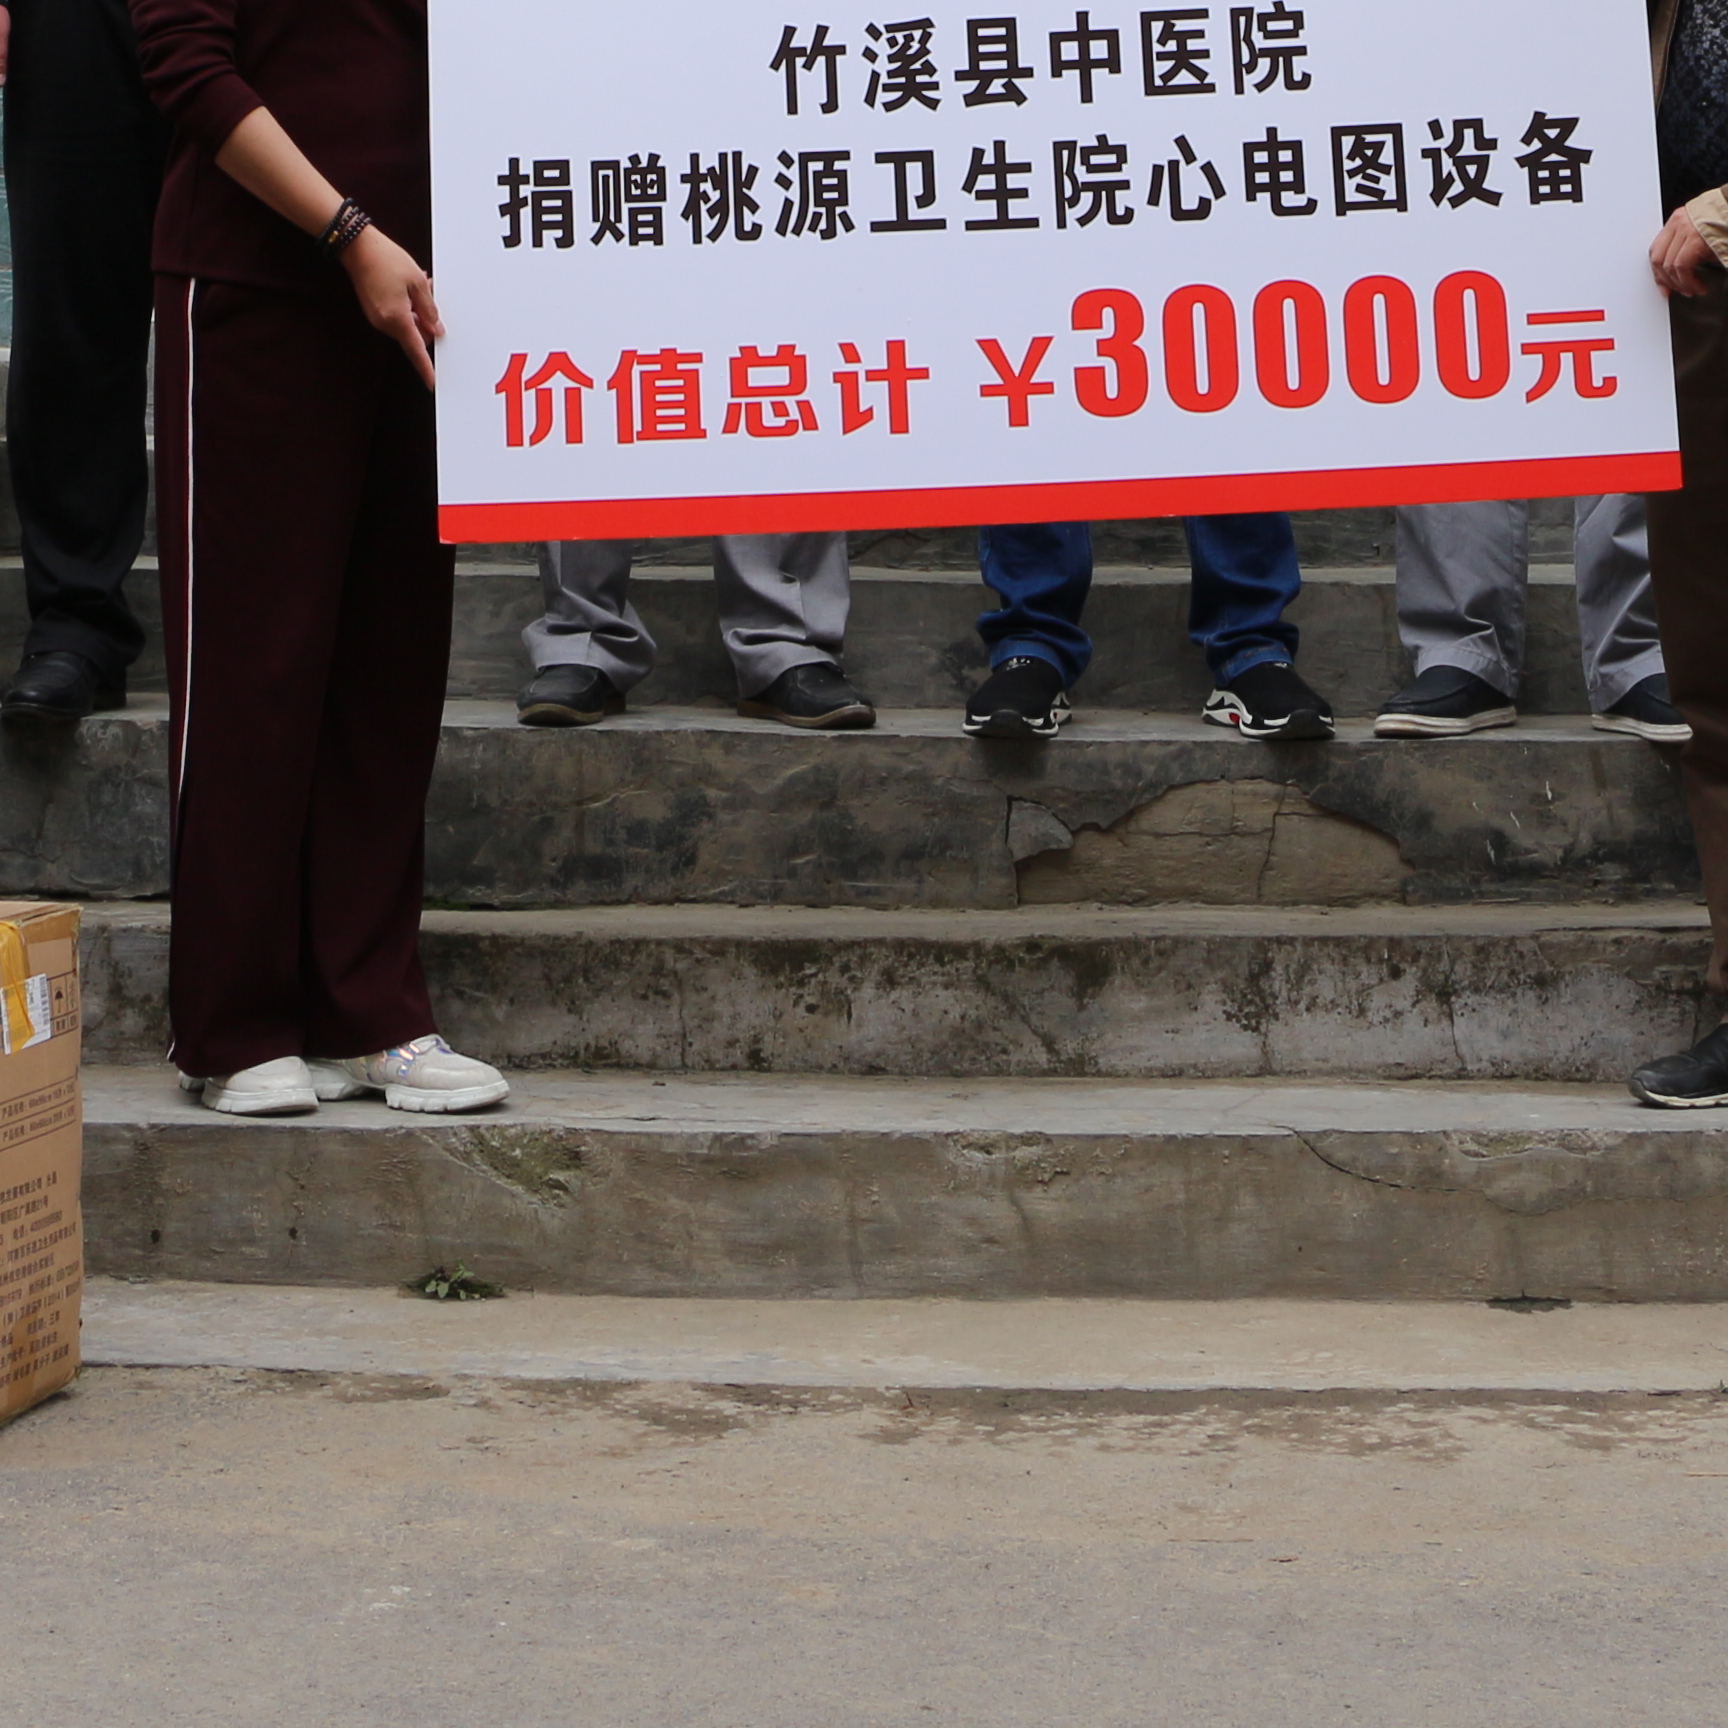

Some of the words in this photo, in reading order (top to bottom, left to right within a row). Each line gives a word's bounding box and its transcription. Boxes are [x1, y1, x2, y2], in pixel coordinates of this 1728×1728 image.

[767, 0, 1315, 118] 竹溪县中医院
[496, 109, 1598, 253] 捐赠桃源卫生院心电图设备
[493, 339, 931, 450] 价值总计
